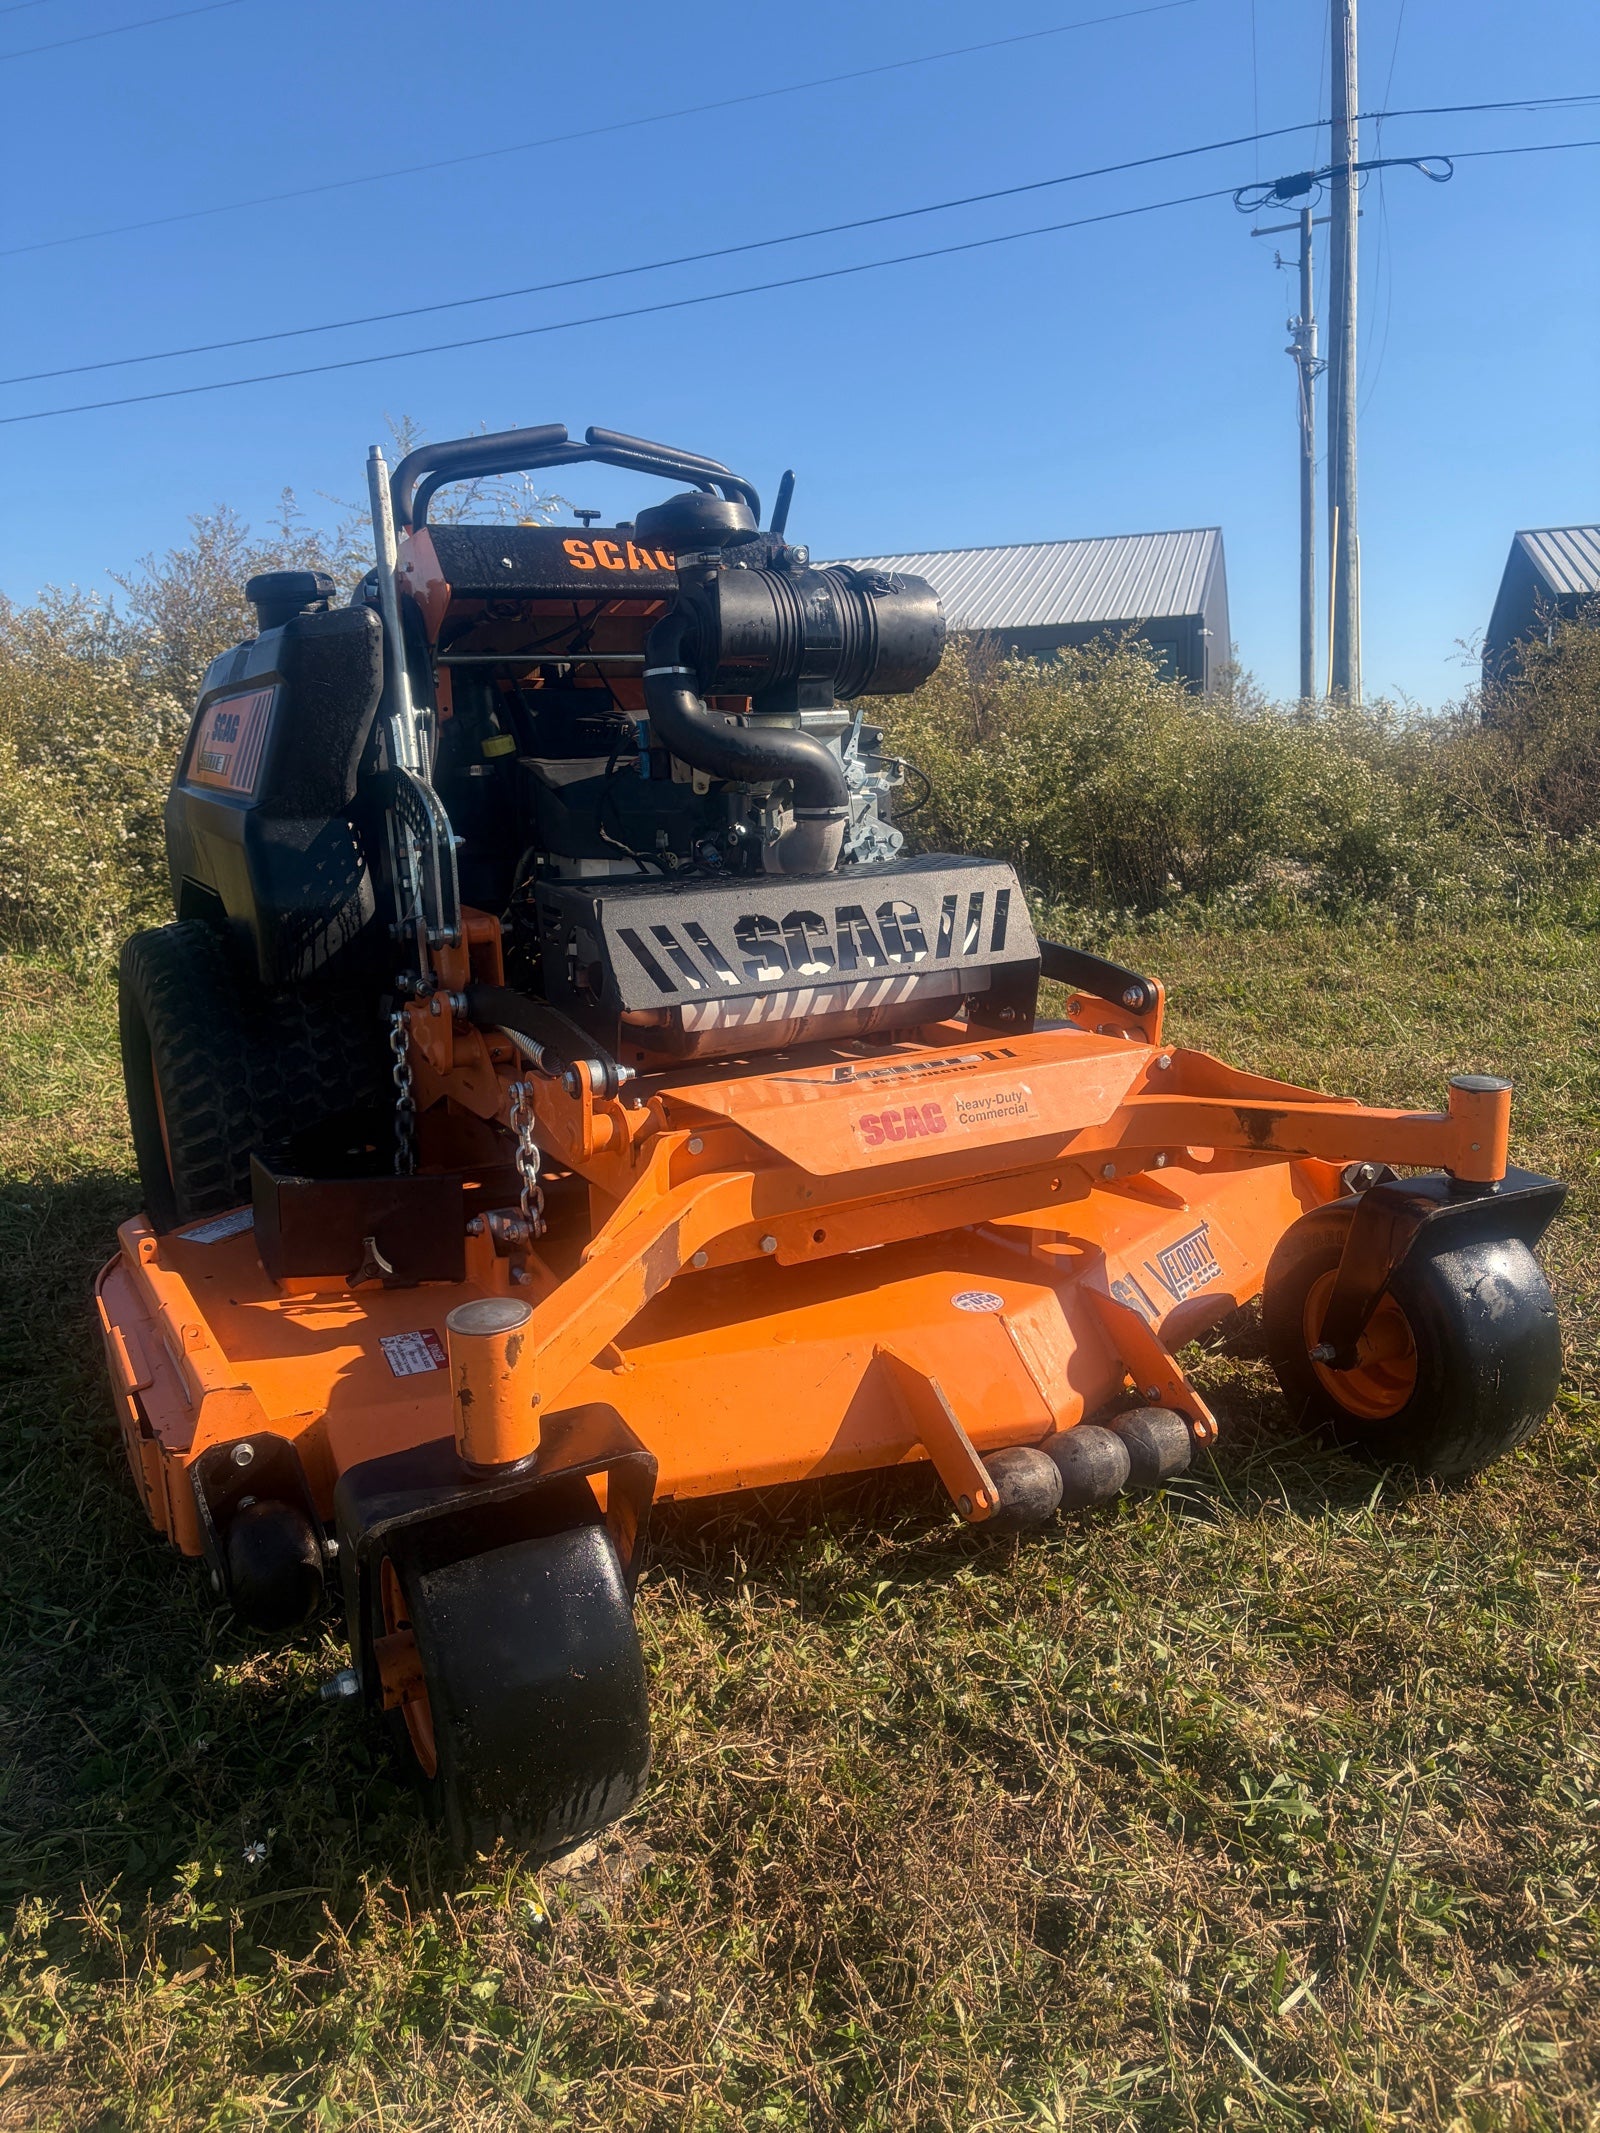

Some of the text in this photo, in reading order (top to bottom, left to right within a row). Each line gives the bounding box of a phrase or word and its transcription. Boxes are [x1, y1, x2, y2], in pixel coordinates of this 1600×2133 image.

[212, 713, 241, 743] SCAG
[733, 900, 929, 982] SCAG
[956, 1091, 1022, 1112] Heavy-Duty
[959, 1102, 1028, 1124] Commercial
[858, 1102, 948, 1146] SCAG
[1143, 1219, 1214, 1302] VELOCITY
[1177, 1261, 1221, 1301] PLUS
[970, 1294, 999, 1305] USA
